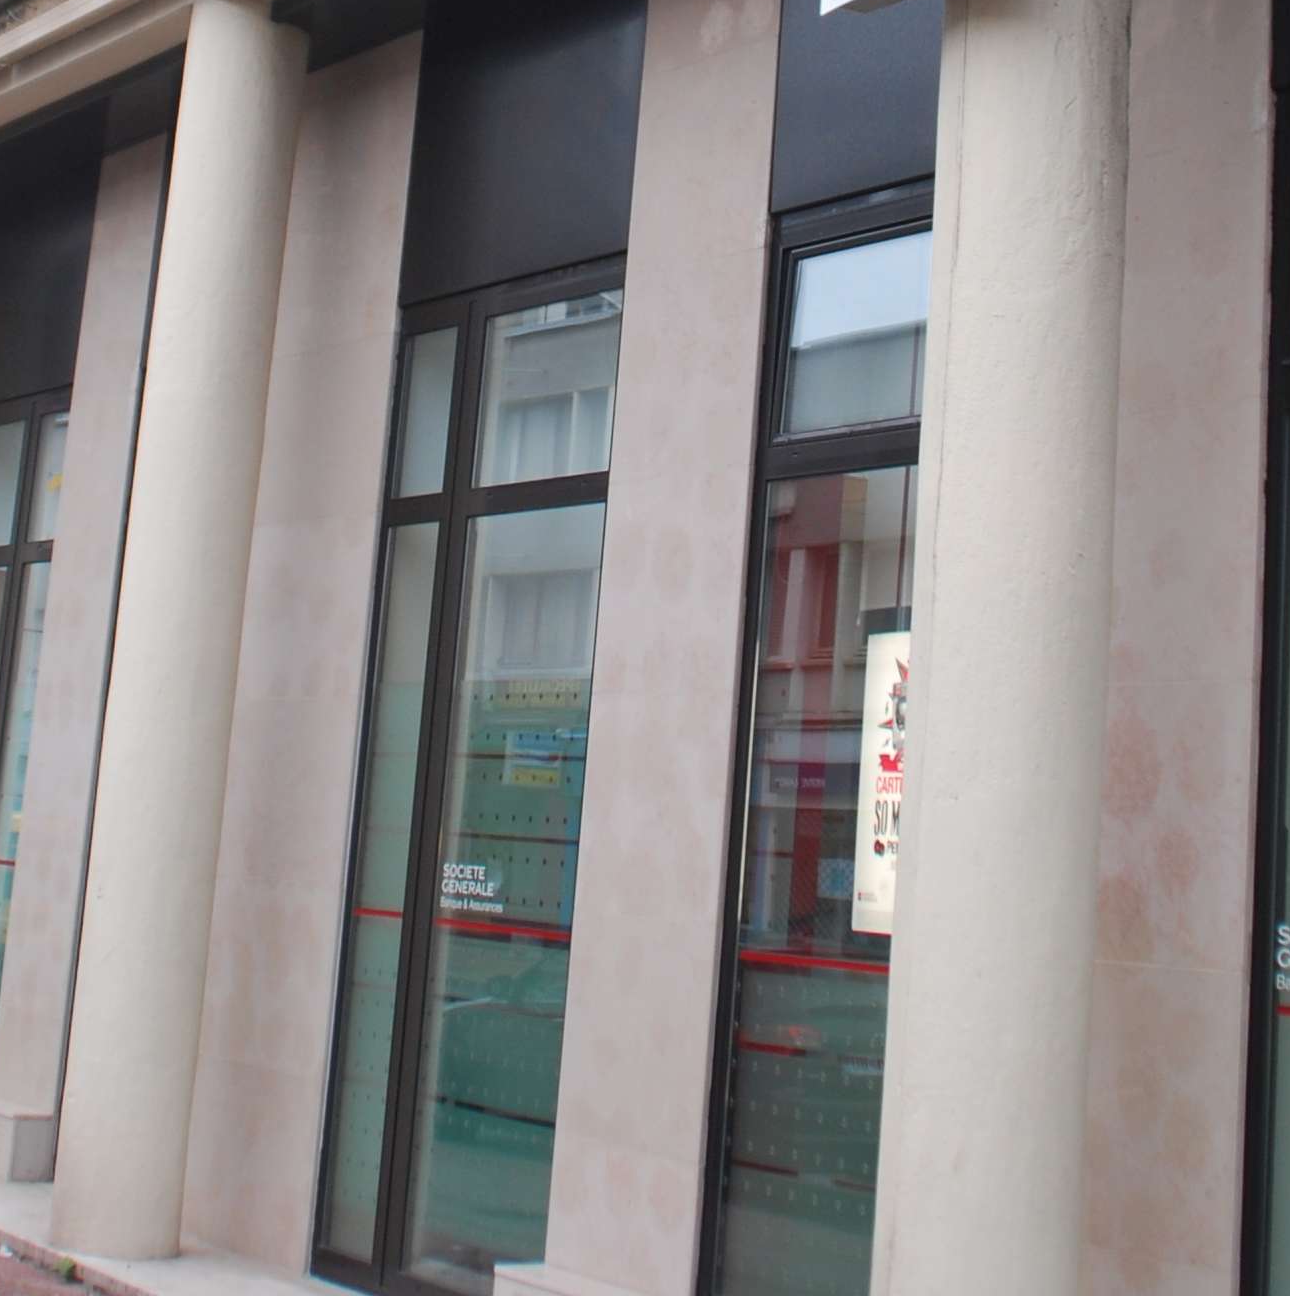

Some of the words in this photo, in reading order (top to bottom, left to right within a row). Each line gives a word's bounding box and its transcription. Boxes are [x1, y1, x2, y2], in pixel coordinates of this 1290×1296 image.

[874, 800, 888, 836] SO
[442, 863, 486, 880] SOCIETE
[441, 879, 495, 897] GENERALE
